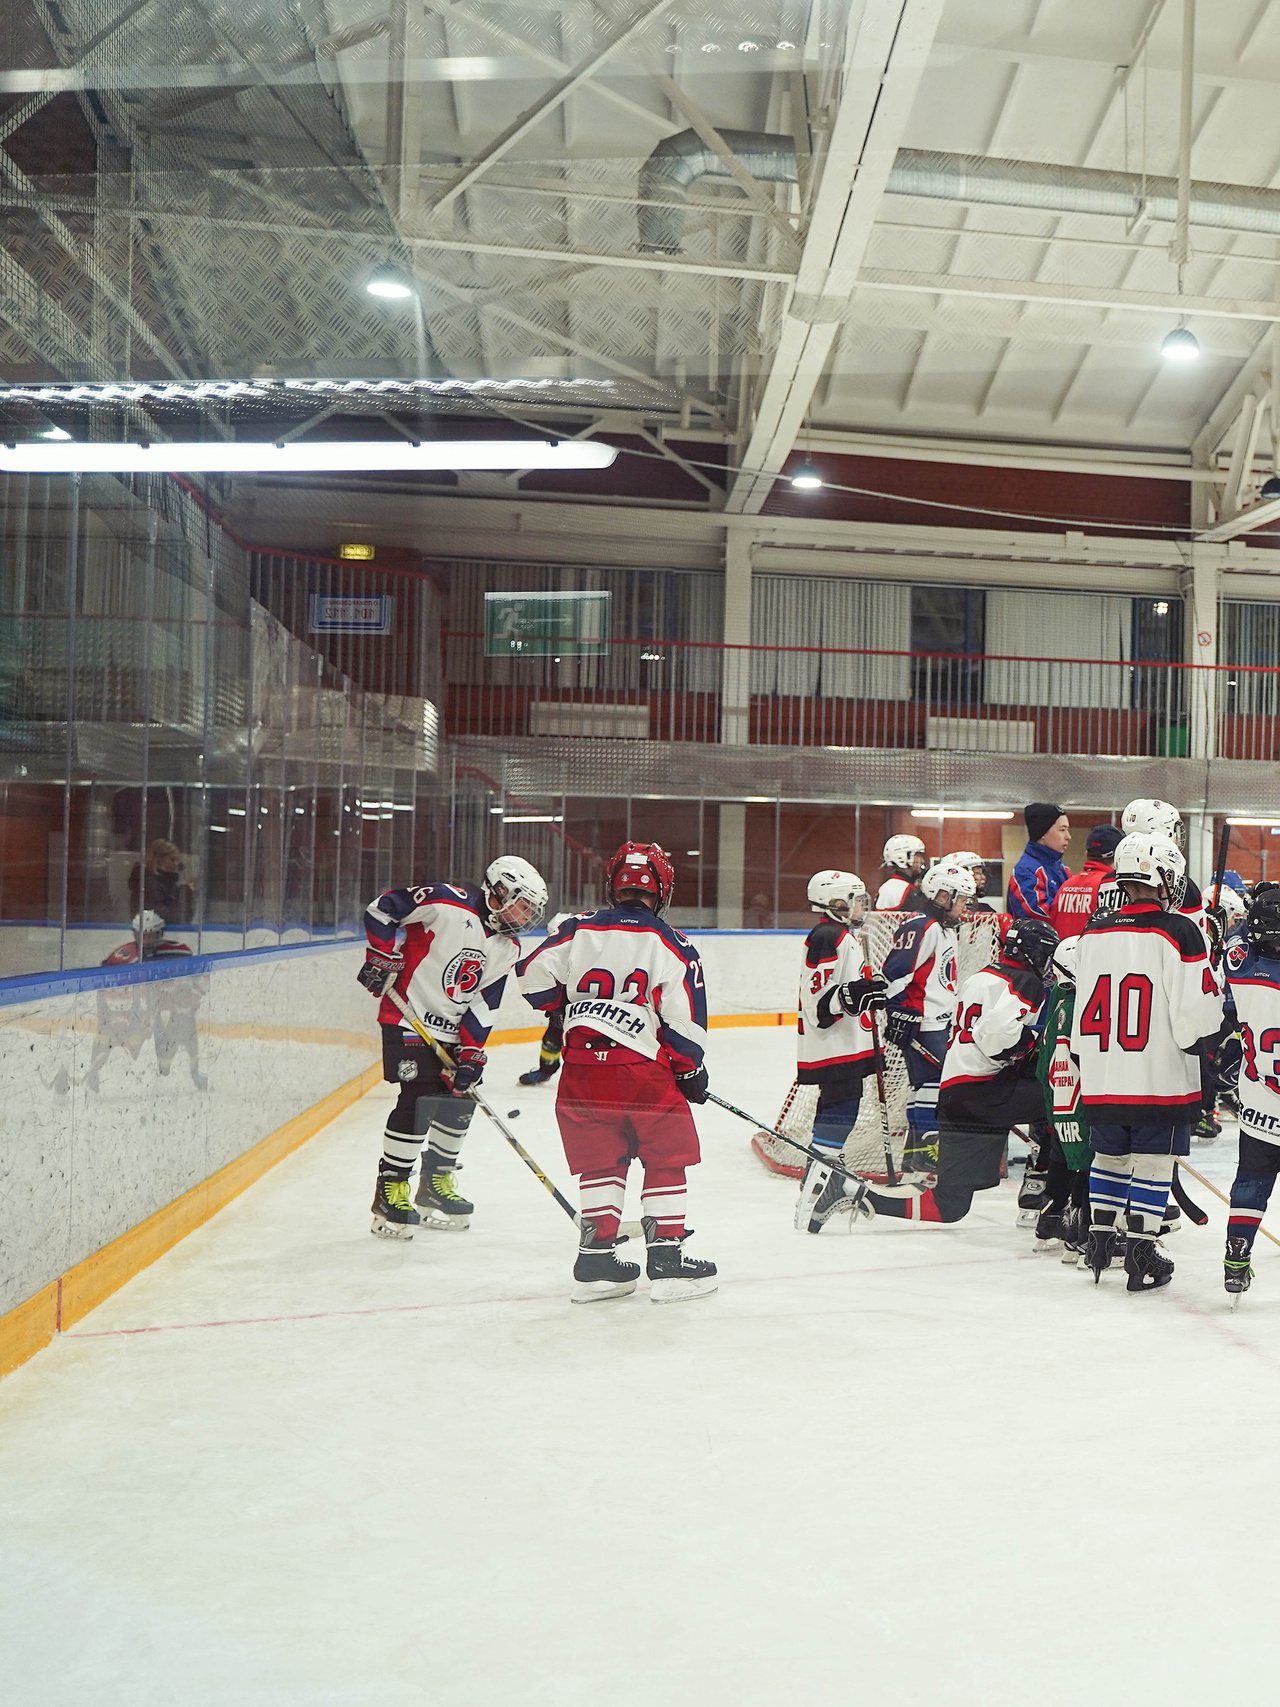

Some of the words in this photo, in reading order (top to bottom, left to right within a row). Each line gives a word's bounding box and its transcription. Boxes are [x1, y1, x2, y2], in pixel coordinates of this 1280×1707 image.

[1057, 893, 1093, 914] VIKHR
[568, 1001, 646, 1034] КВАНТ-Н
[1080, 972, 1154, 1053] 40
